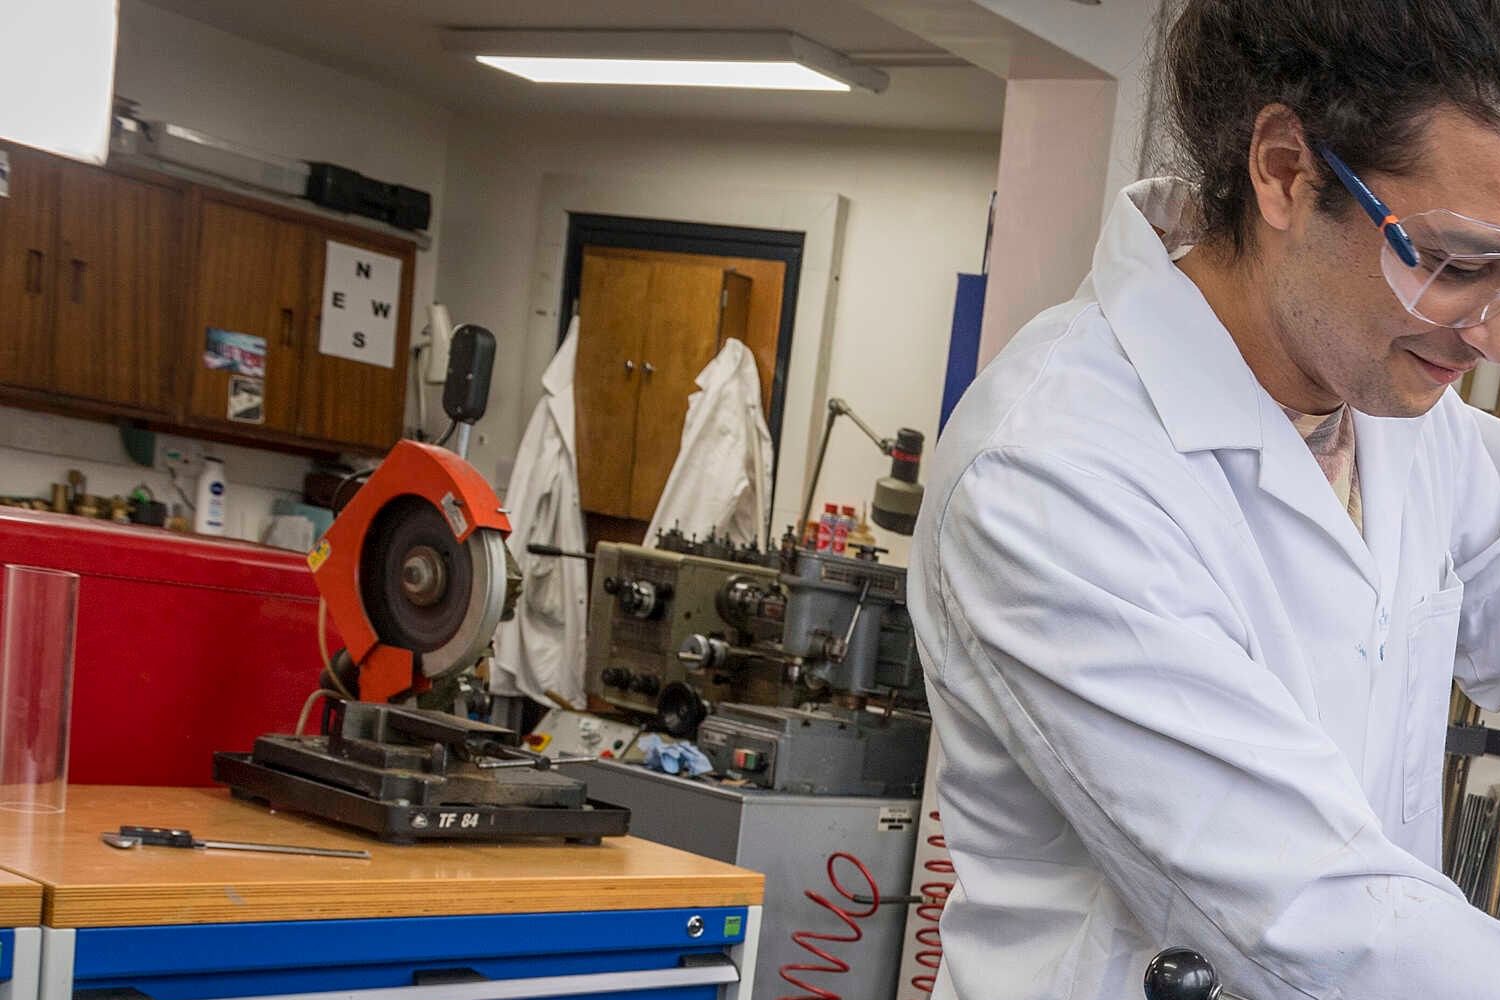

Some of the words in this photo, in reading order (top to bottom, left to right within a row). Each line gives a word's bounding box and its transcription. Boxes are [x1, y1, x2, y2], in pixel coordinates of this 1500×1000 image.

[355, 261, 371, 279] N
[331, 291, 346, 310] E
[371, 299, 392, 319] W
[351, 331, 367, 349] S
[438, 813, 457, 828] TF
[460, 813, 480, 828] 84
